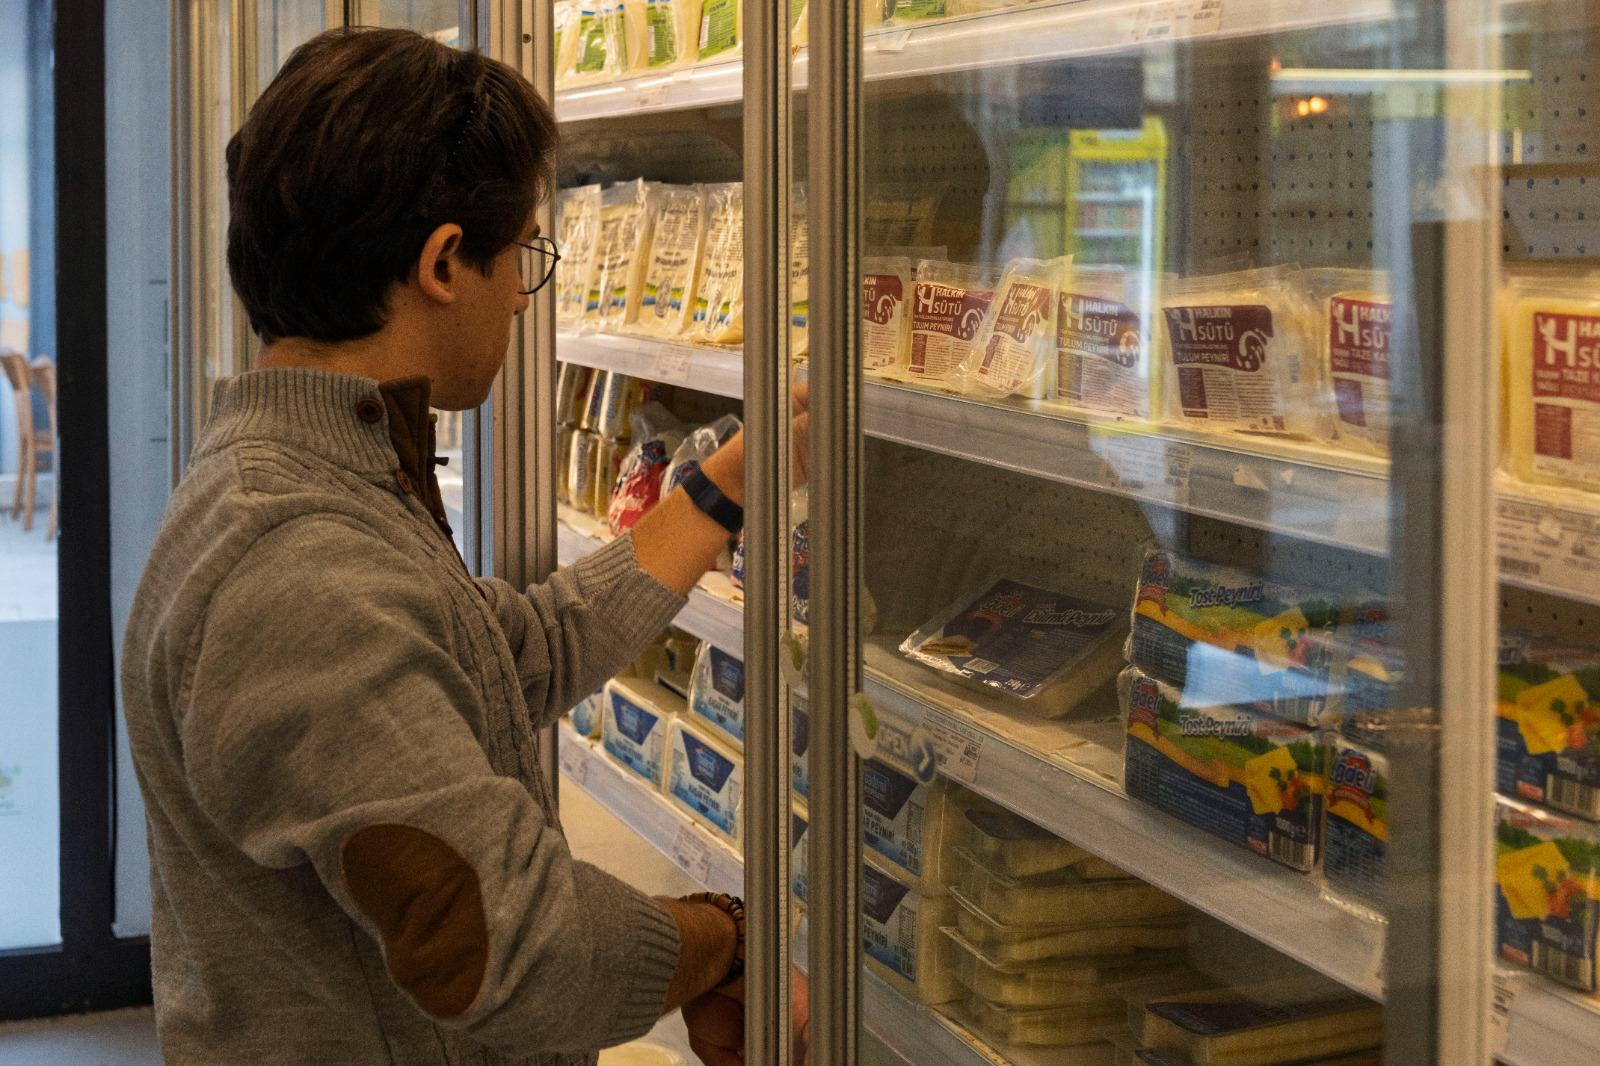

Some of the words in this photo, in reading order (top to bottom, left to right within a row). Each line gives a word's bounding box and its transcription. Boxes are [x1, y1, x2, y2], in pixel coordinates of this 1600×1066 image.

[935, 287, 967, 298] HALKIN
[933, 301, 962, 316] SÜTÜ
[1085, 299, 1118, 316] HALKIN
[1195, 307, 1232, 319] HALKIN
[1084, 316, 1118, 337] SÜTÜ
[1197, 321, 1234, 341] SÜTÜ
